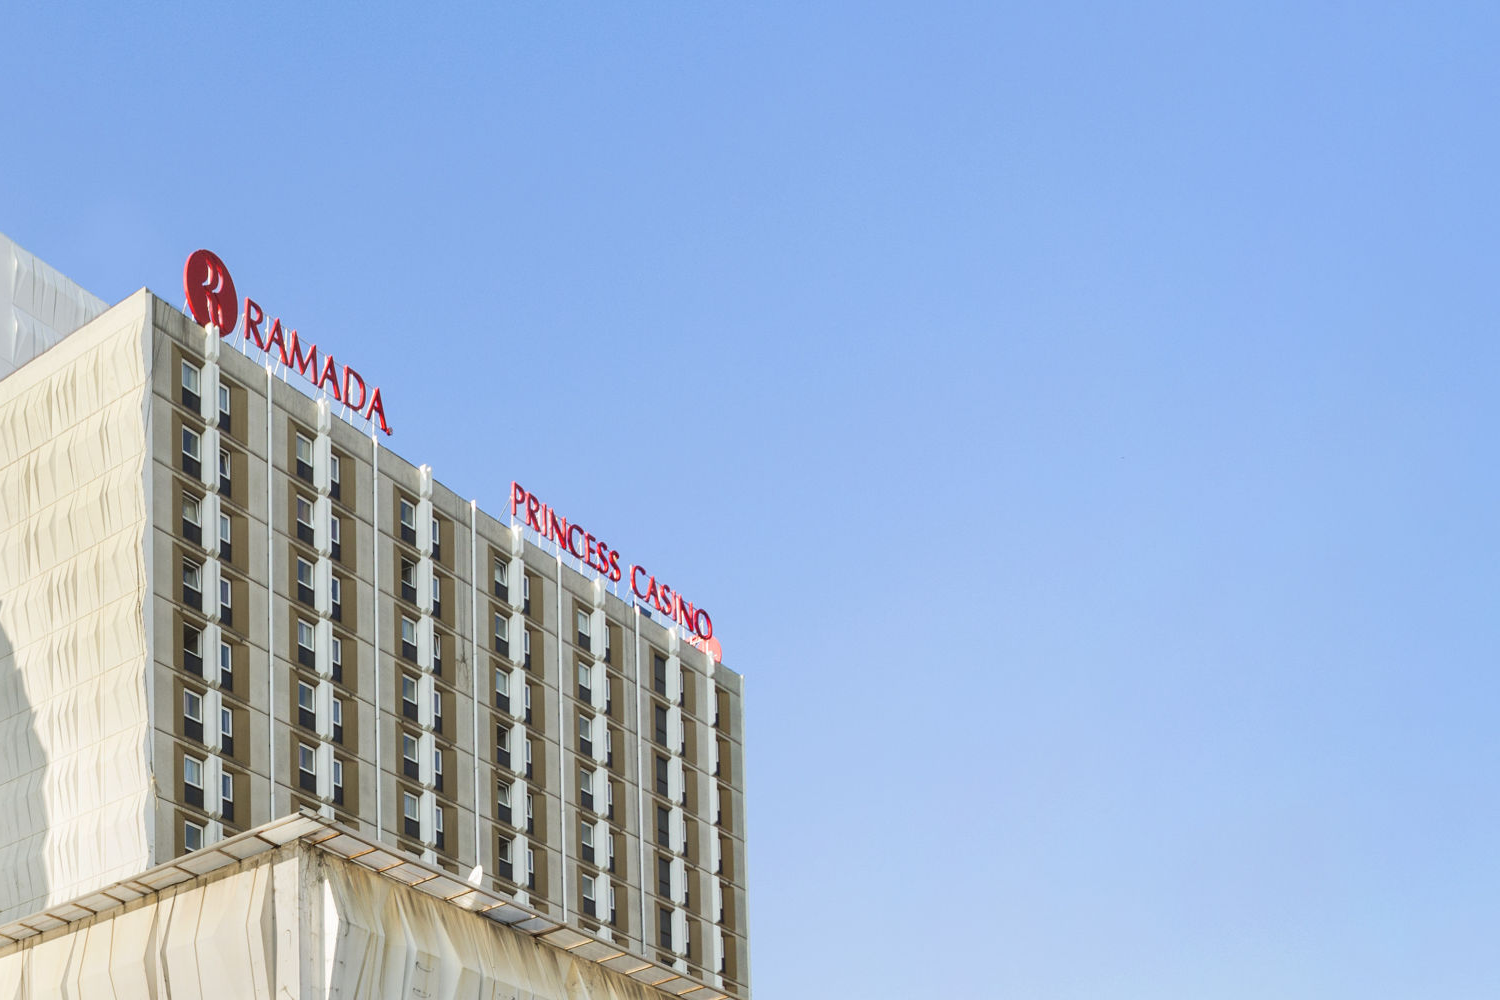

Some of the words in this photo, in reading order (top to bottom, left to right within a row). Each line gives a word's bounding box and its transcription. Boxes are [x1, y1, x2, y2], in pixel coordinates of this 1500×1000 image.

[244, 297, 388, 433] RAMADA
[511, 480, 621, 582] PRINCESS
[630, 565, 713, 640] CASINO
